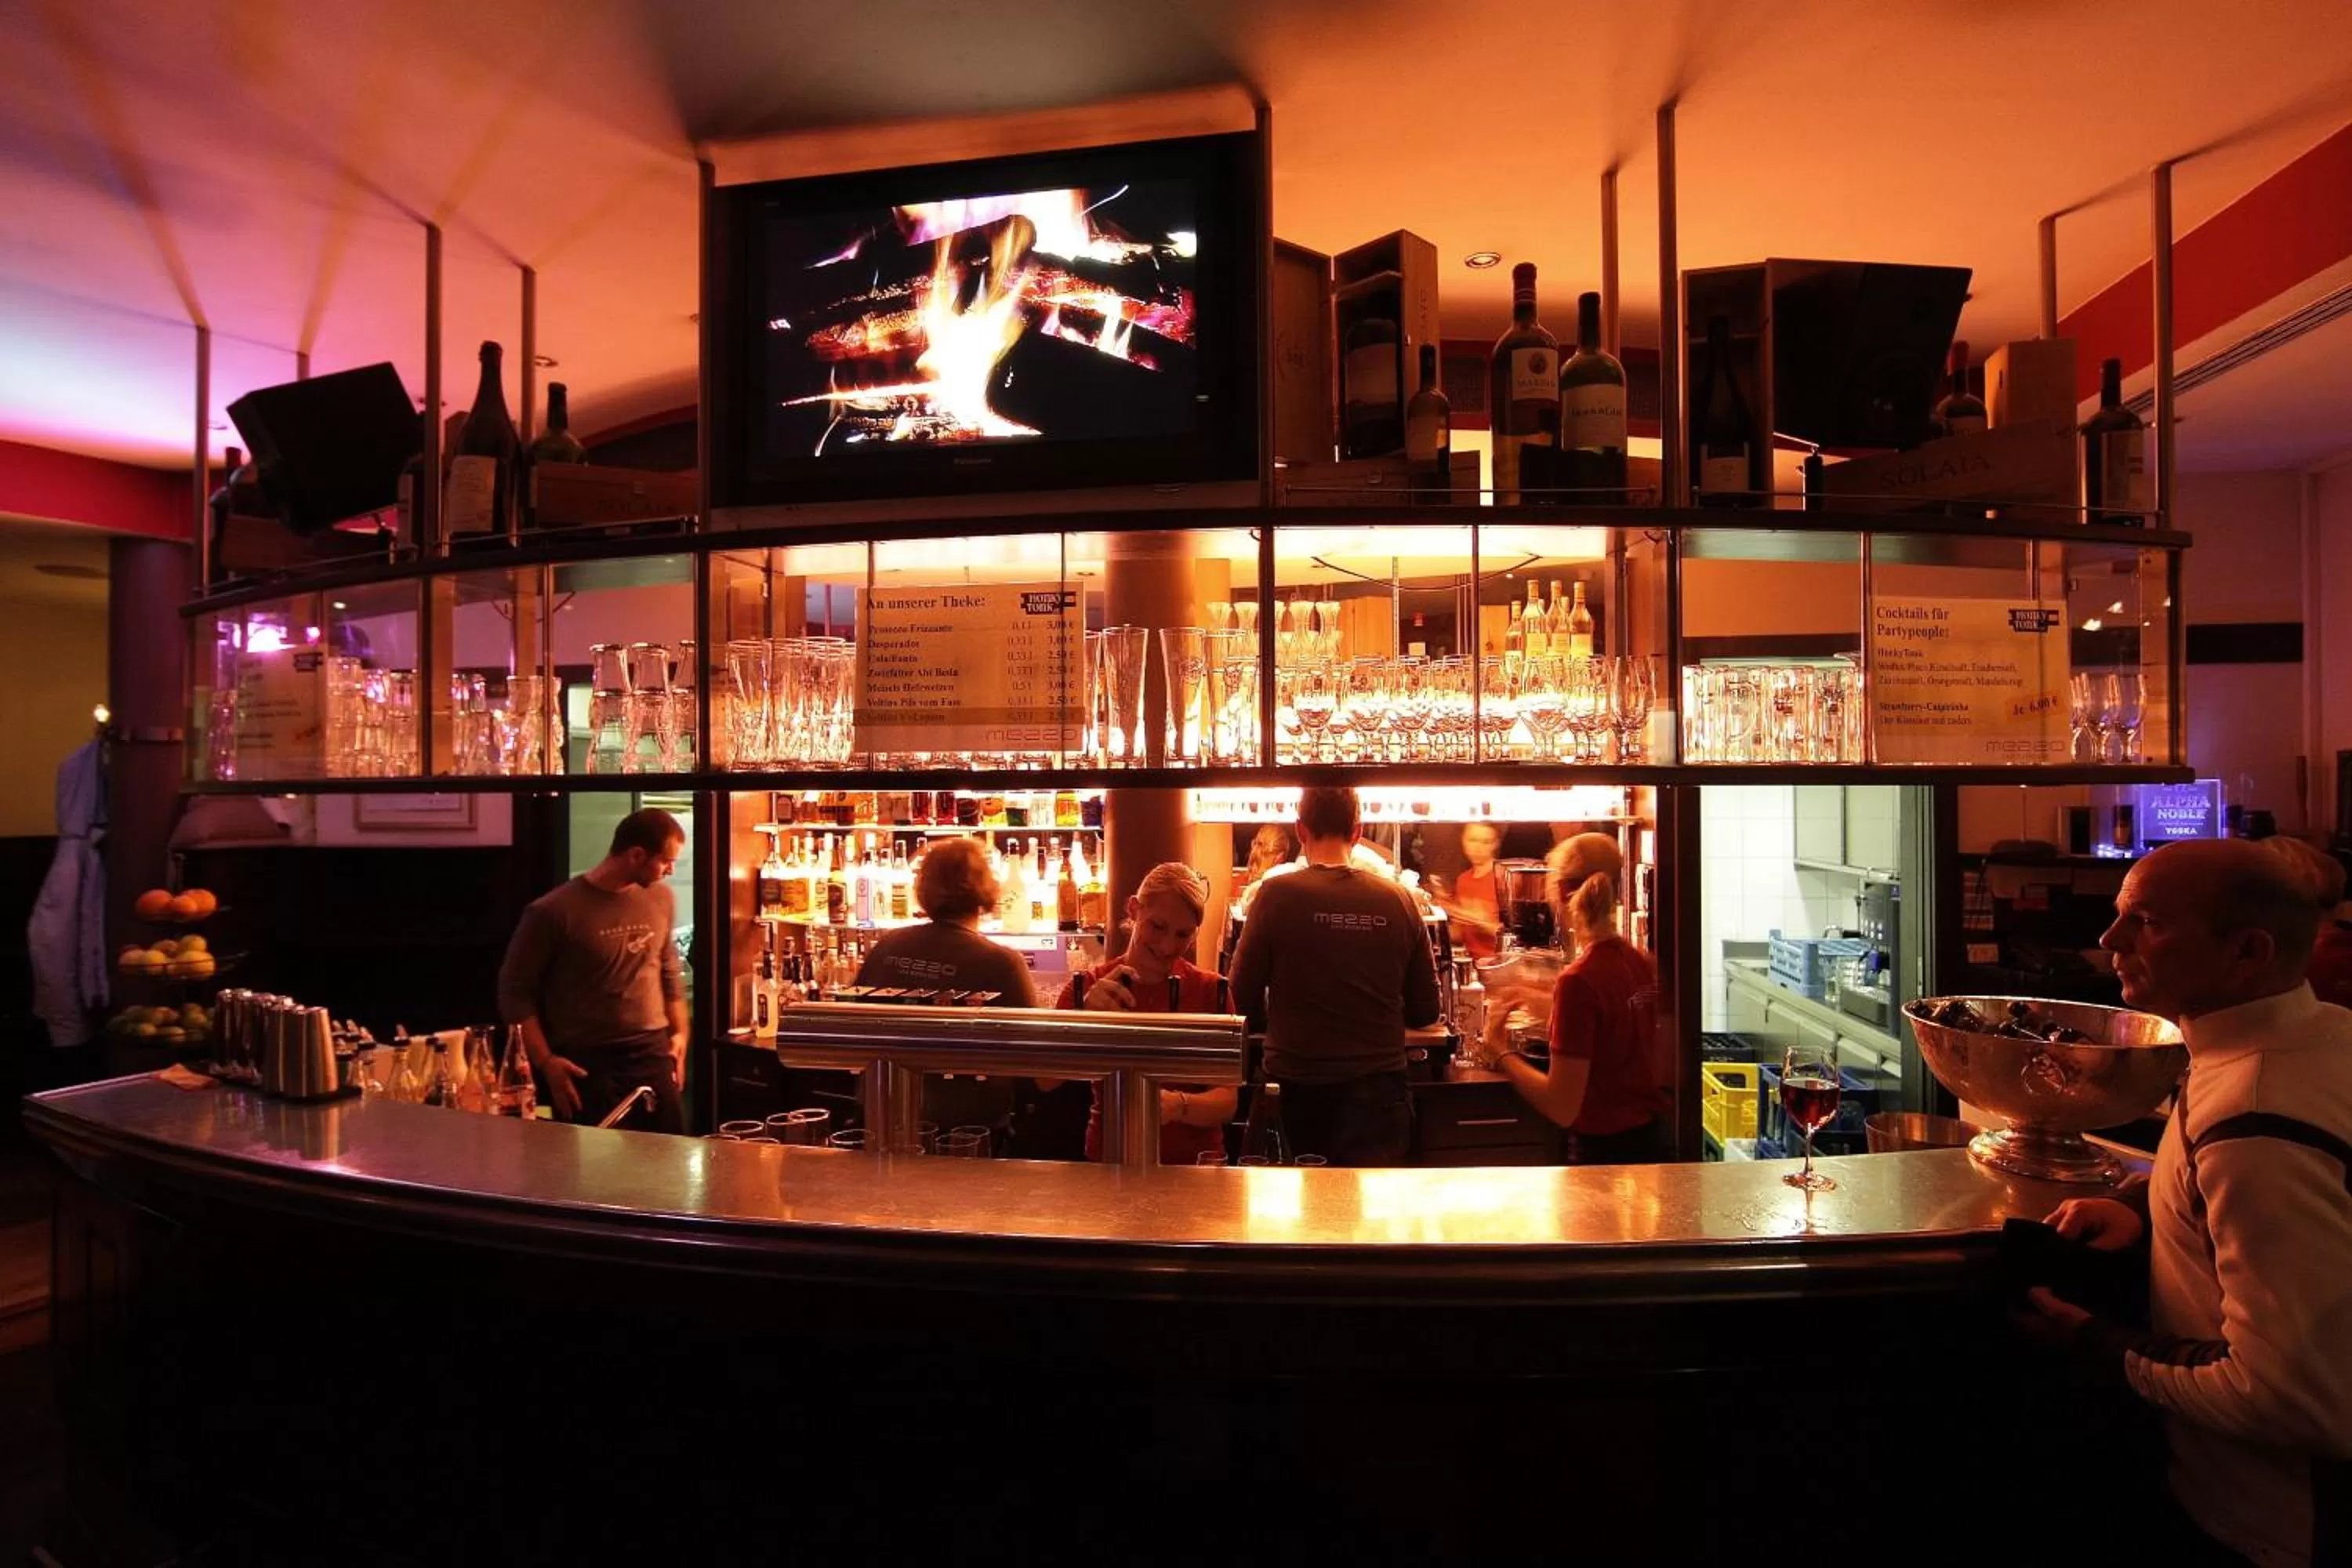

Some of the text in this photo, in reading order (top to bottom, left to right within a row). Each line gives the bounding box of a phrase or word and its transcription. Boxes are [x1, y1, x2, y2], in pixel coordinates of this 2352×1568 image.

[888, 598, 938, 610] unserer
[941, 595, 985, 608] Theke:
[1876, 606, 1950, 620] Cocktails für
[1877, 624, 1950, 640] Partypeople:
[2151, 795, 2211, 808] ALPHA
[2157, 808, 2207, 819] NOBLE
